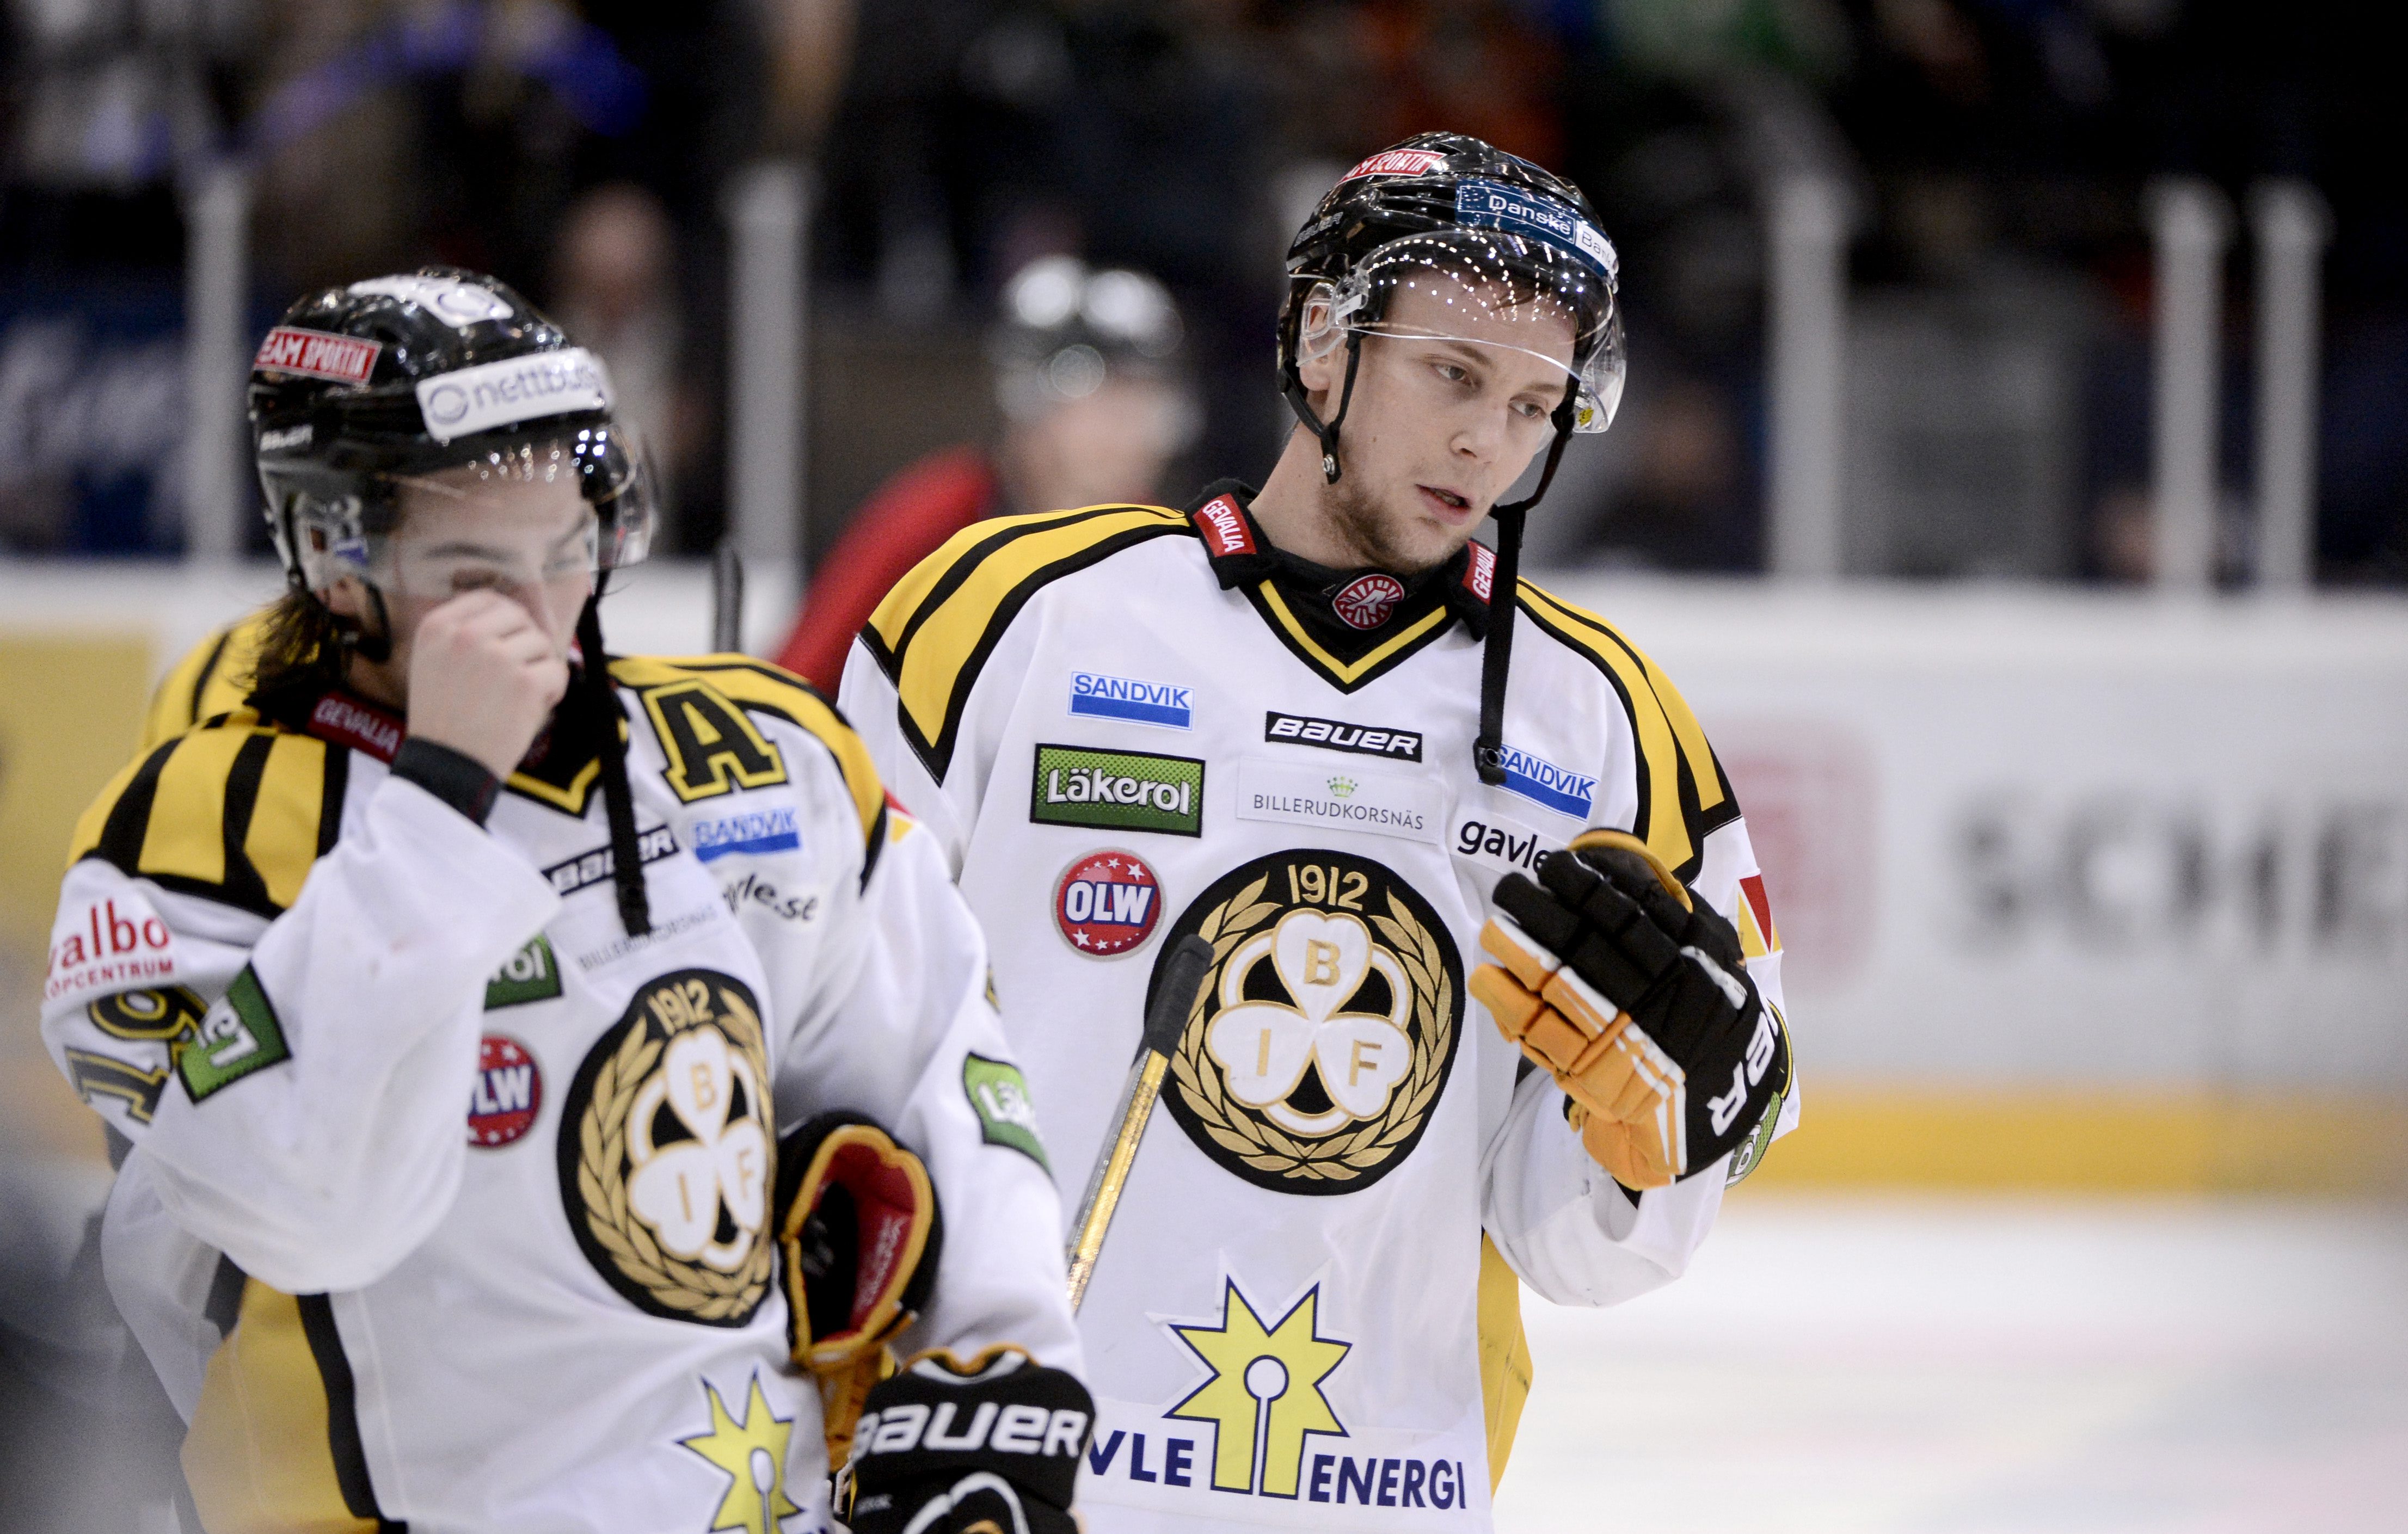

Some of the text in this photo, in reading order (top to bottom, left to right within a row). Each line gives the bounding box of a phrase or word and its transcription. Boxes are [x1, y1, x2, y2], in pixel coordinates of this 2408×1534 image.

[1488, 194, 1571, 235] Danske
[1202, 500, 1245, 553] GEVALIA
[1472, 546, 1496, 599] GEVALIA
[1074, 674, 1190, 709] SANDVIK
[314, 698, 401, 755] GEVALIA
[642, 683, 788, 803] A
[1046, 767, 1190, 816] Läkerol
[1498, 746, 1596, 801] SANDVIK
[1253, 794, 1423, 830] BILLERUDKORSNÄS
[551, 828, 675, 893] BAR
[1066, 882, 1152, 925] OLW
[1287, 864, 1369, 911] 1912
[1303, 938, 1341, 986] B
[647, 978, 715, 1035] 1912
[691, 1063, 716, 1111] B
[1348, 1039, 1382, 1086] F
[736, 1147, 754, 1201] F
[1309, 1454, 1467, 1510] ENERGI
